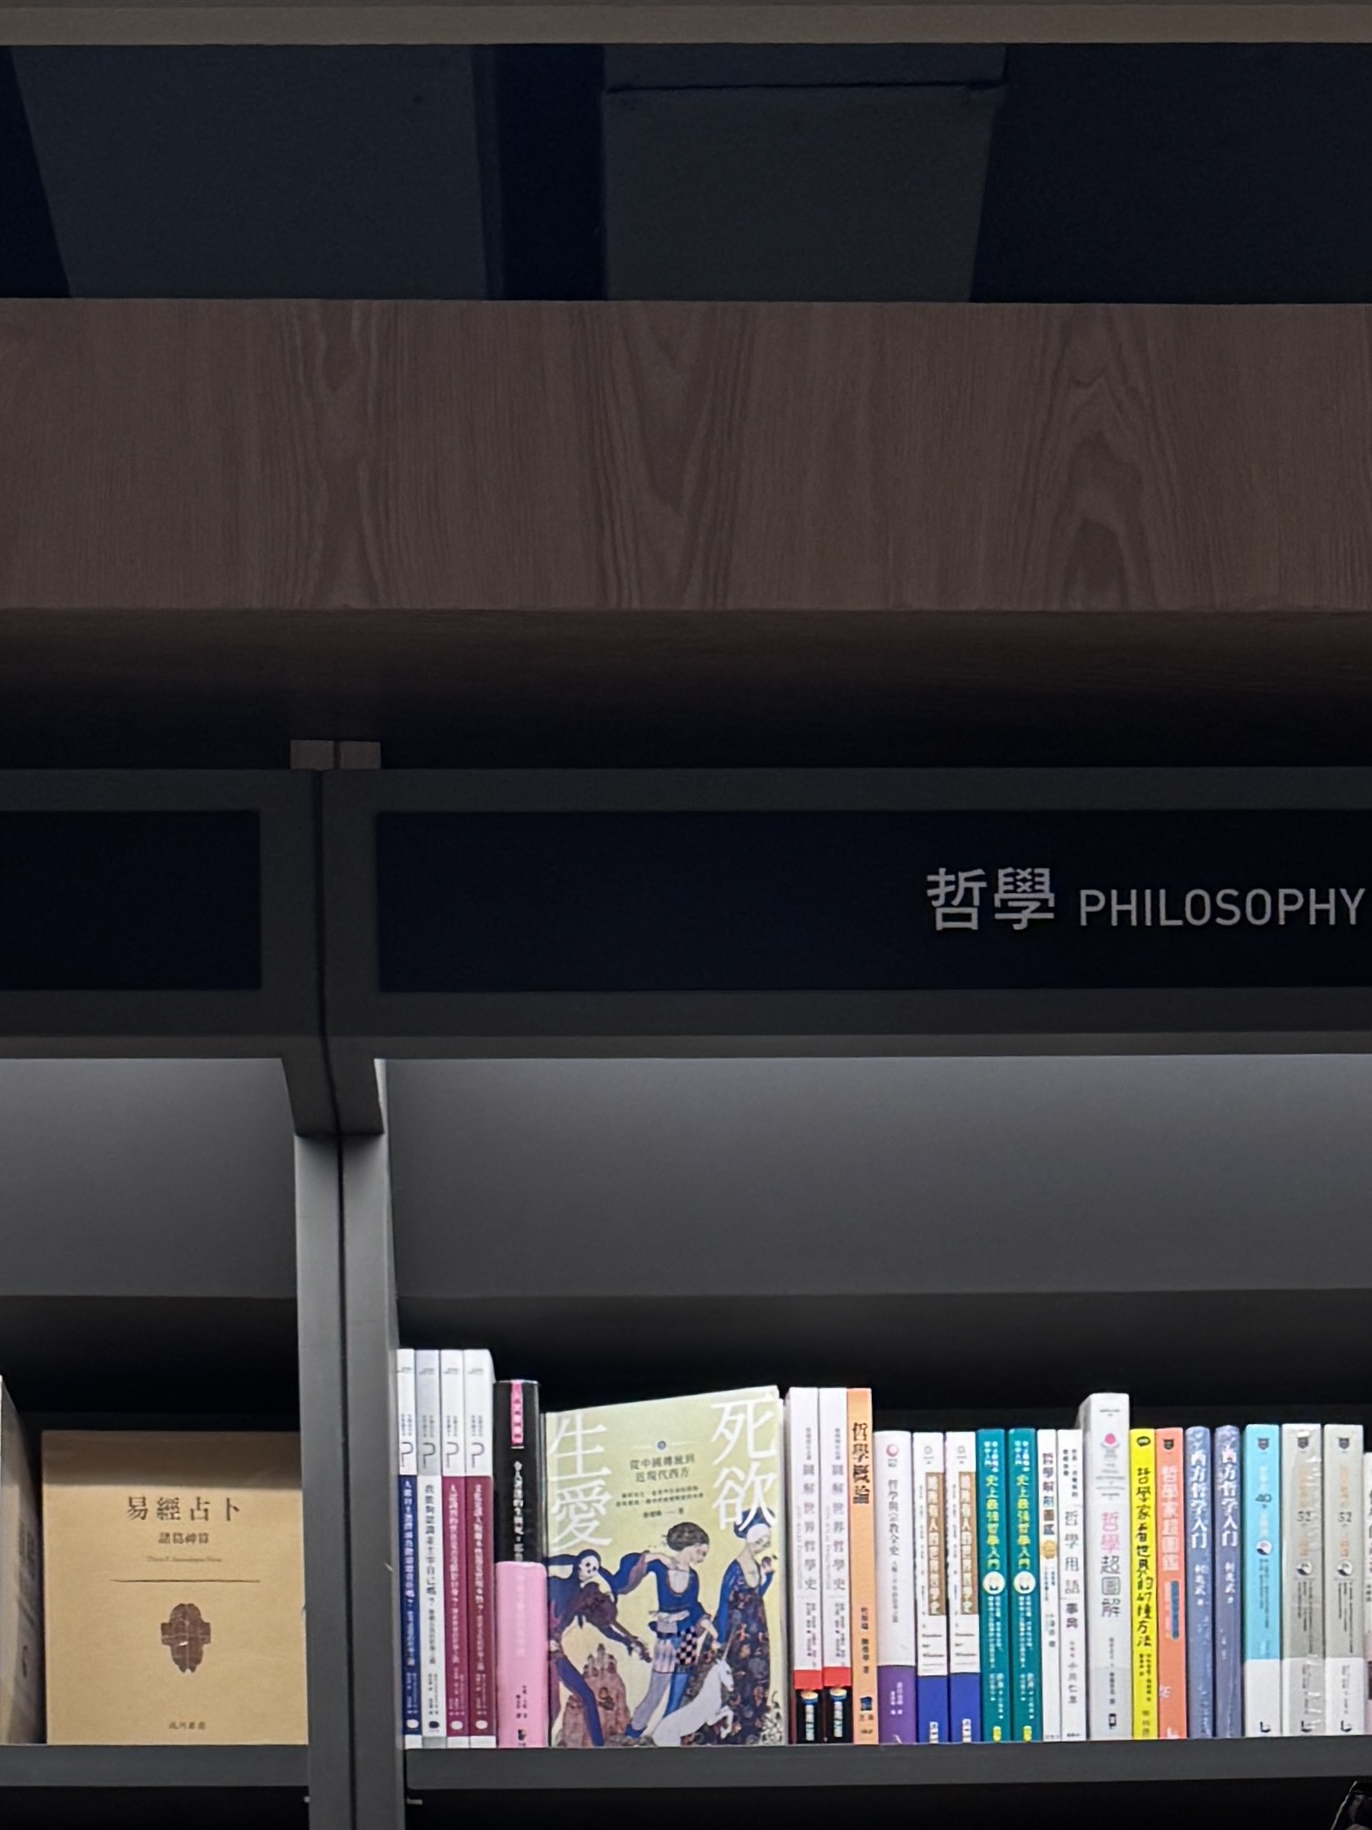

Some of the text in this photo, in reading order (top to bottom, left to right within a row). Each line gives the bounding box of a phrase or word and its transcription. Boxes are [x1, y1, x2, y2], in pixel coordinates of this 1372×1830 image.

[924, 865, 1366, 933] 哲學 PHILOSOPHY
[852, 1422, 870, 1505] 哲學概論
[1189, 1448, 1209, 1549] 西方哲学入门
[126, 1496, 240, 1522] 易經占卜
[1100, 1511, 1122, 1618] 哲學超圖解
